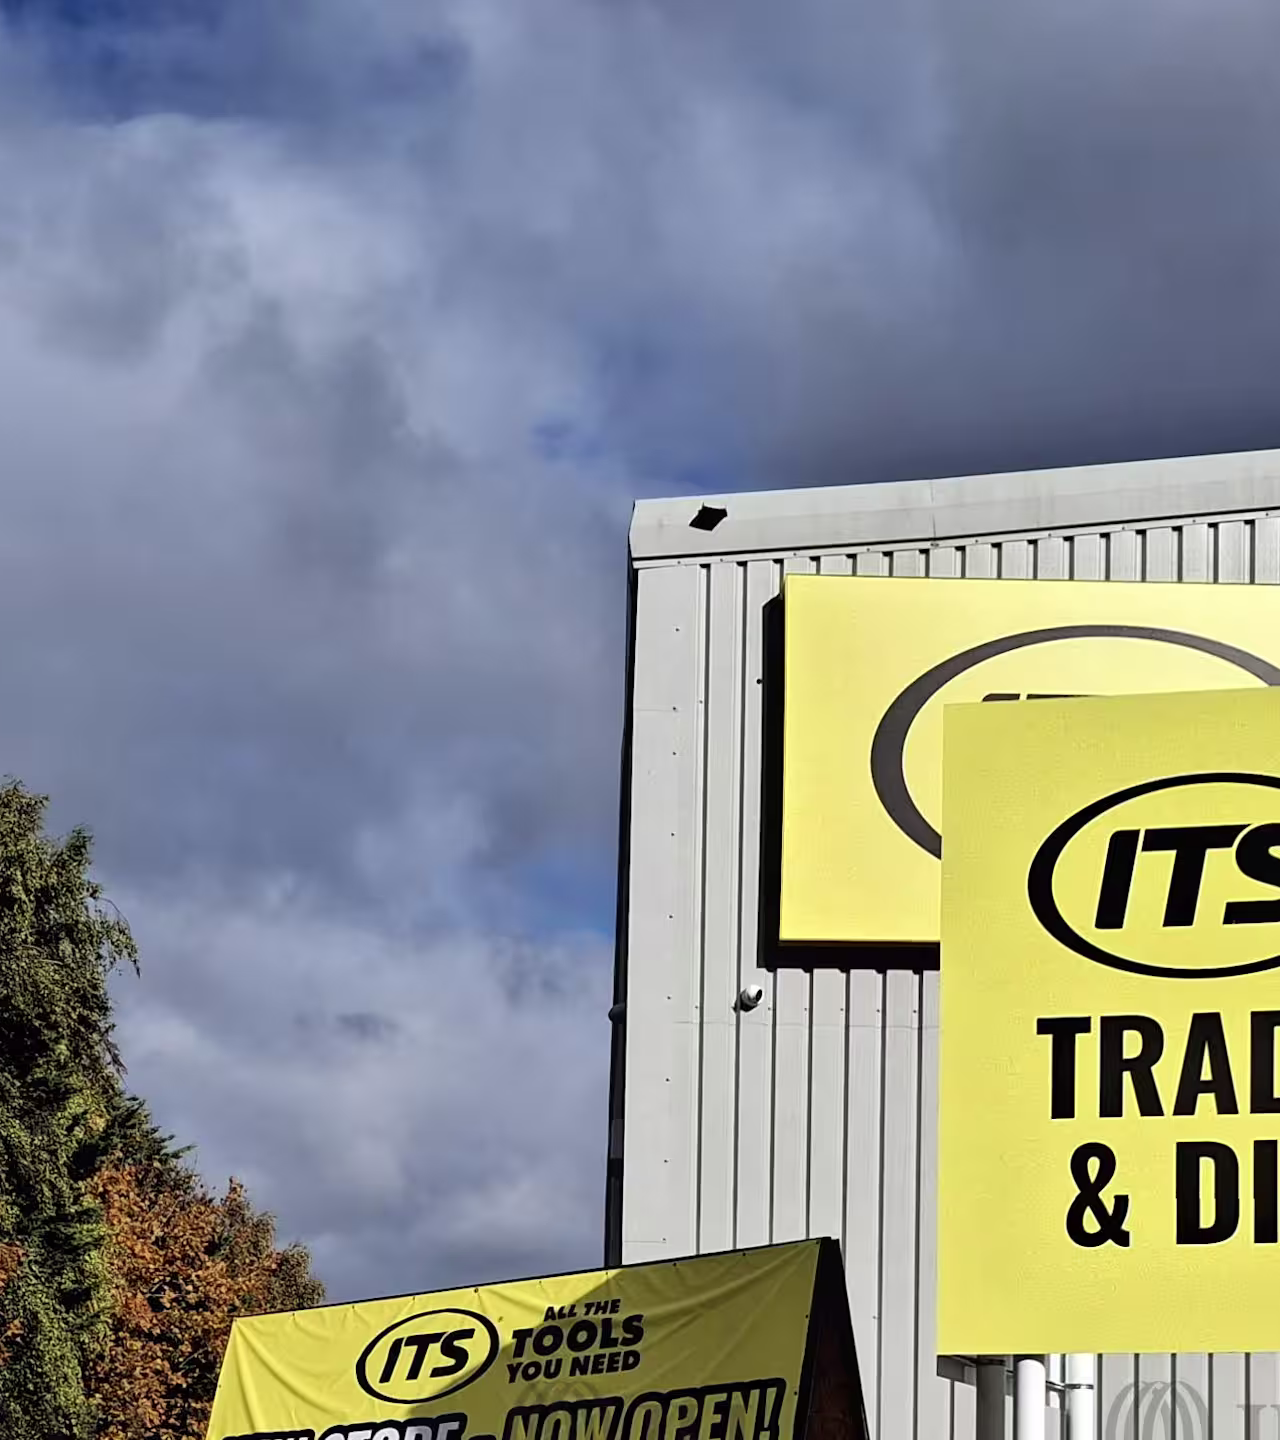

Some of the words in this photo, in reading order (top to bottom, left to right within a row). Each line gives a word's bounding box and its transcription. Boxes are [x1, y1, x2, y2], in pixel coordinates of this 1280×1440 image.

[1066, 1142, 1131, 1248] &
[543, 1304, 577, 1322] ALL
[584, 1299, 621, 1315] THE
[379, 1328, 476, 1384] ITS
[511, 1314, 645, 1359] TOOLS
[506, 1358, 563, 1384] YOU
[569, 1350, 641, 1377] NEED
